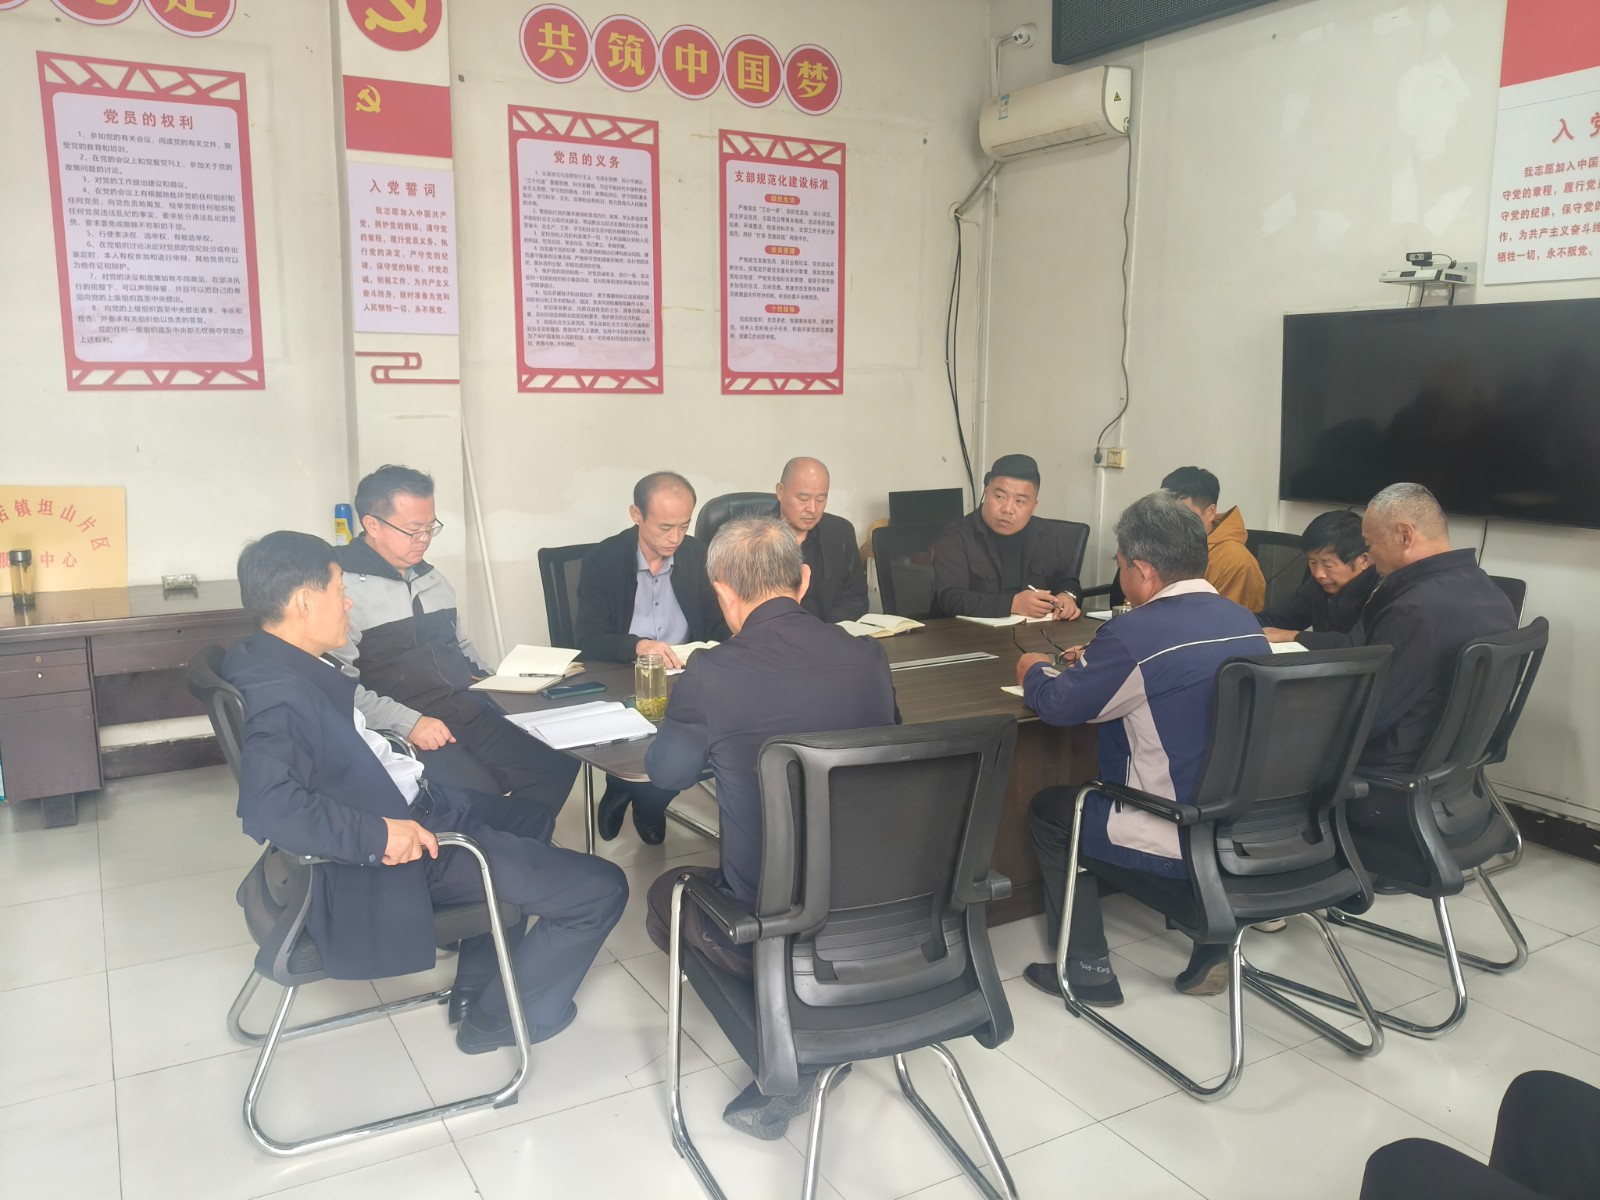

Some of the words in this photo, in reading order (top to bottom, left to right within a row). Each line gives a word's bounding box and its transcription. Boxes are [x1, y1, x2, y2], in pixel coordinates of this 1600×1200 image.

[537, 22, 829, 98] 共筑中国梦
[103, 108, 193, 130] 党员的权利
[554, 150, 620, 168] 党员的义务
[369, 179, 436, 198] 入党誓词
[734, 170, 829, 190] 支部规范化建设标准
[1502, 179, 1600, 201] 守党的章程，履行党
